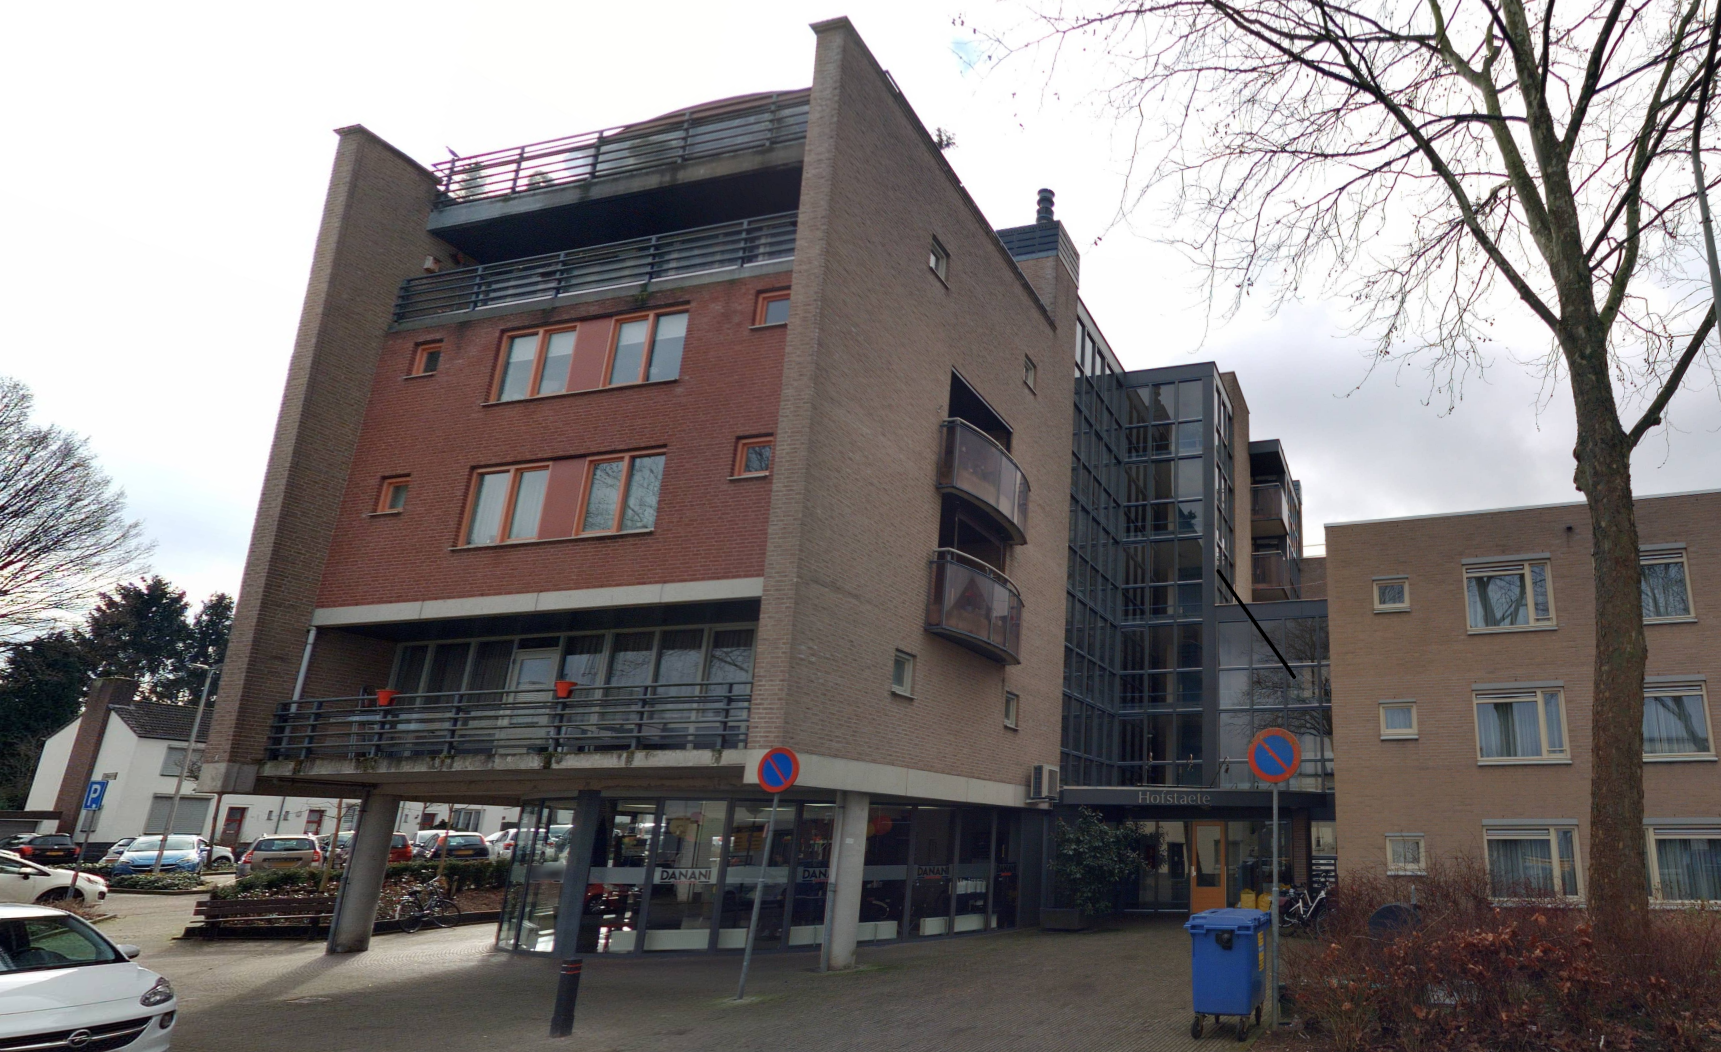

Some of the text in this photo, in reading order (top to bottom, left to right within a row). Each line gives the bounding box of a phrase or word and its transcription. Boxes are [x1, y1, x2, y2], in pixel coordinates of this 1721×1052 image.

[87, 784, 101, 806] P
[1138, 790, 1211, 805] Hofstaete
[660, 869, 712, 881] DANANI
[802, 868, 830, 880] DAN
